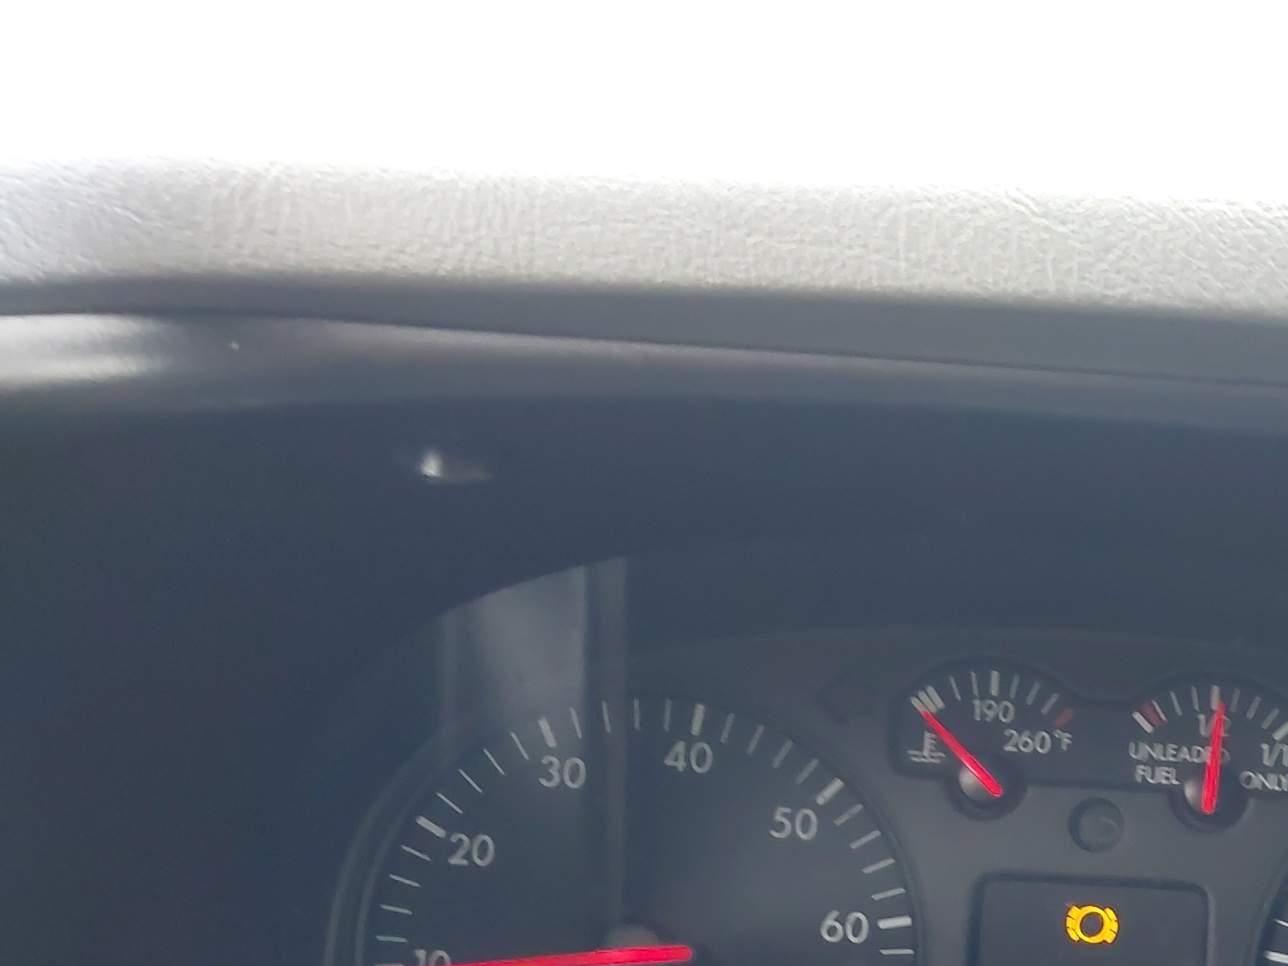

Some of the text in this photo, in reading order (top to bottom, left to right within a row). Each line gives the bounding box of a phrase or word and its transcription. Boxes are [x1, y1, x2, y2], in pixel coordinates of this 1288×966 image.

[973, 699, 1015, 723] 190
[539, 757, 585, 788] 30
[664, 742, 713, 773] 40
[1134, 764, 1180, 784] FUEL
[770, 808, 818, 840] 50
[448, 834, 495, 866] 20
[820, 911, 868, 943] 60
